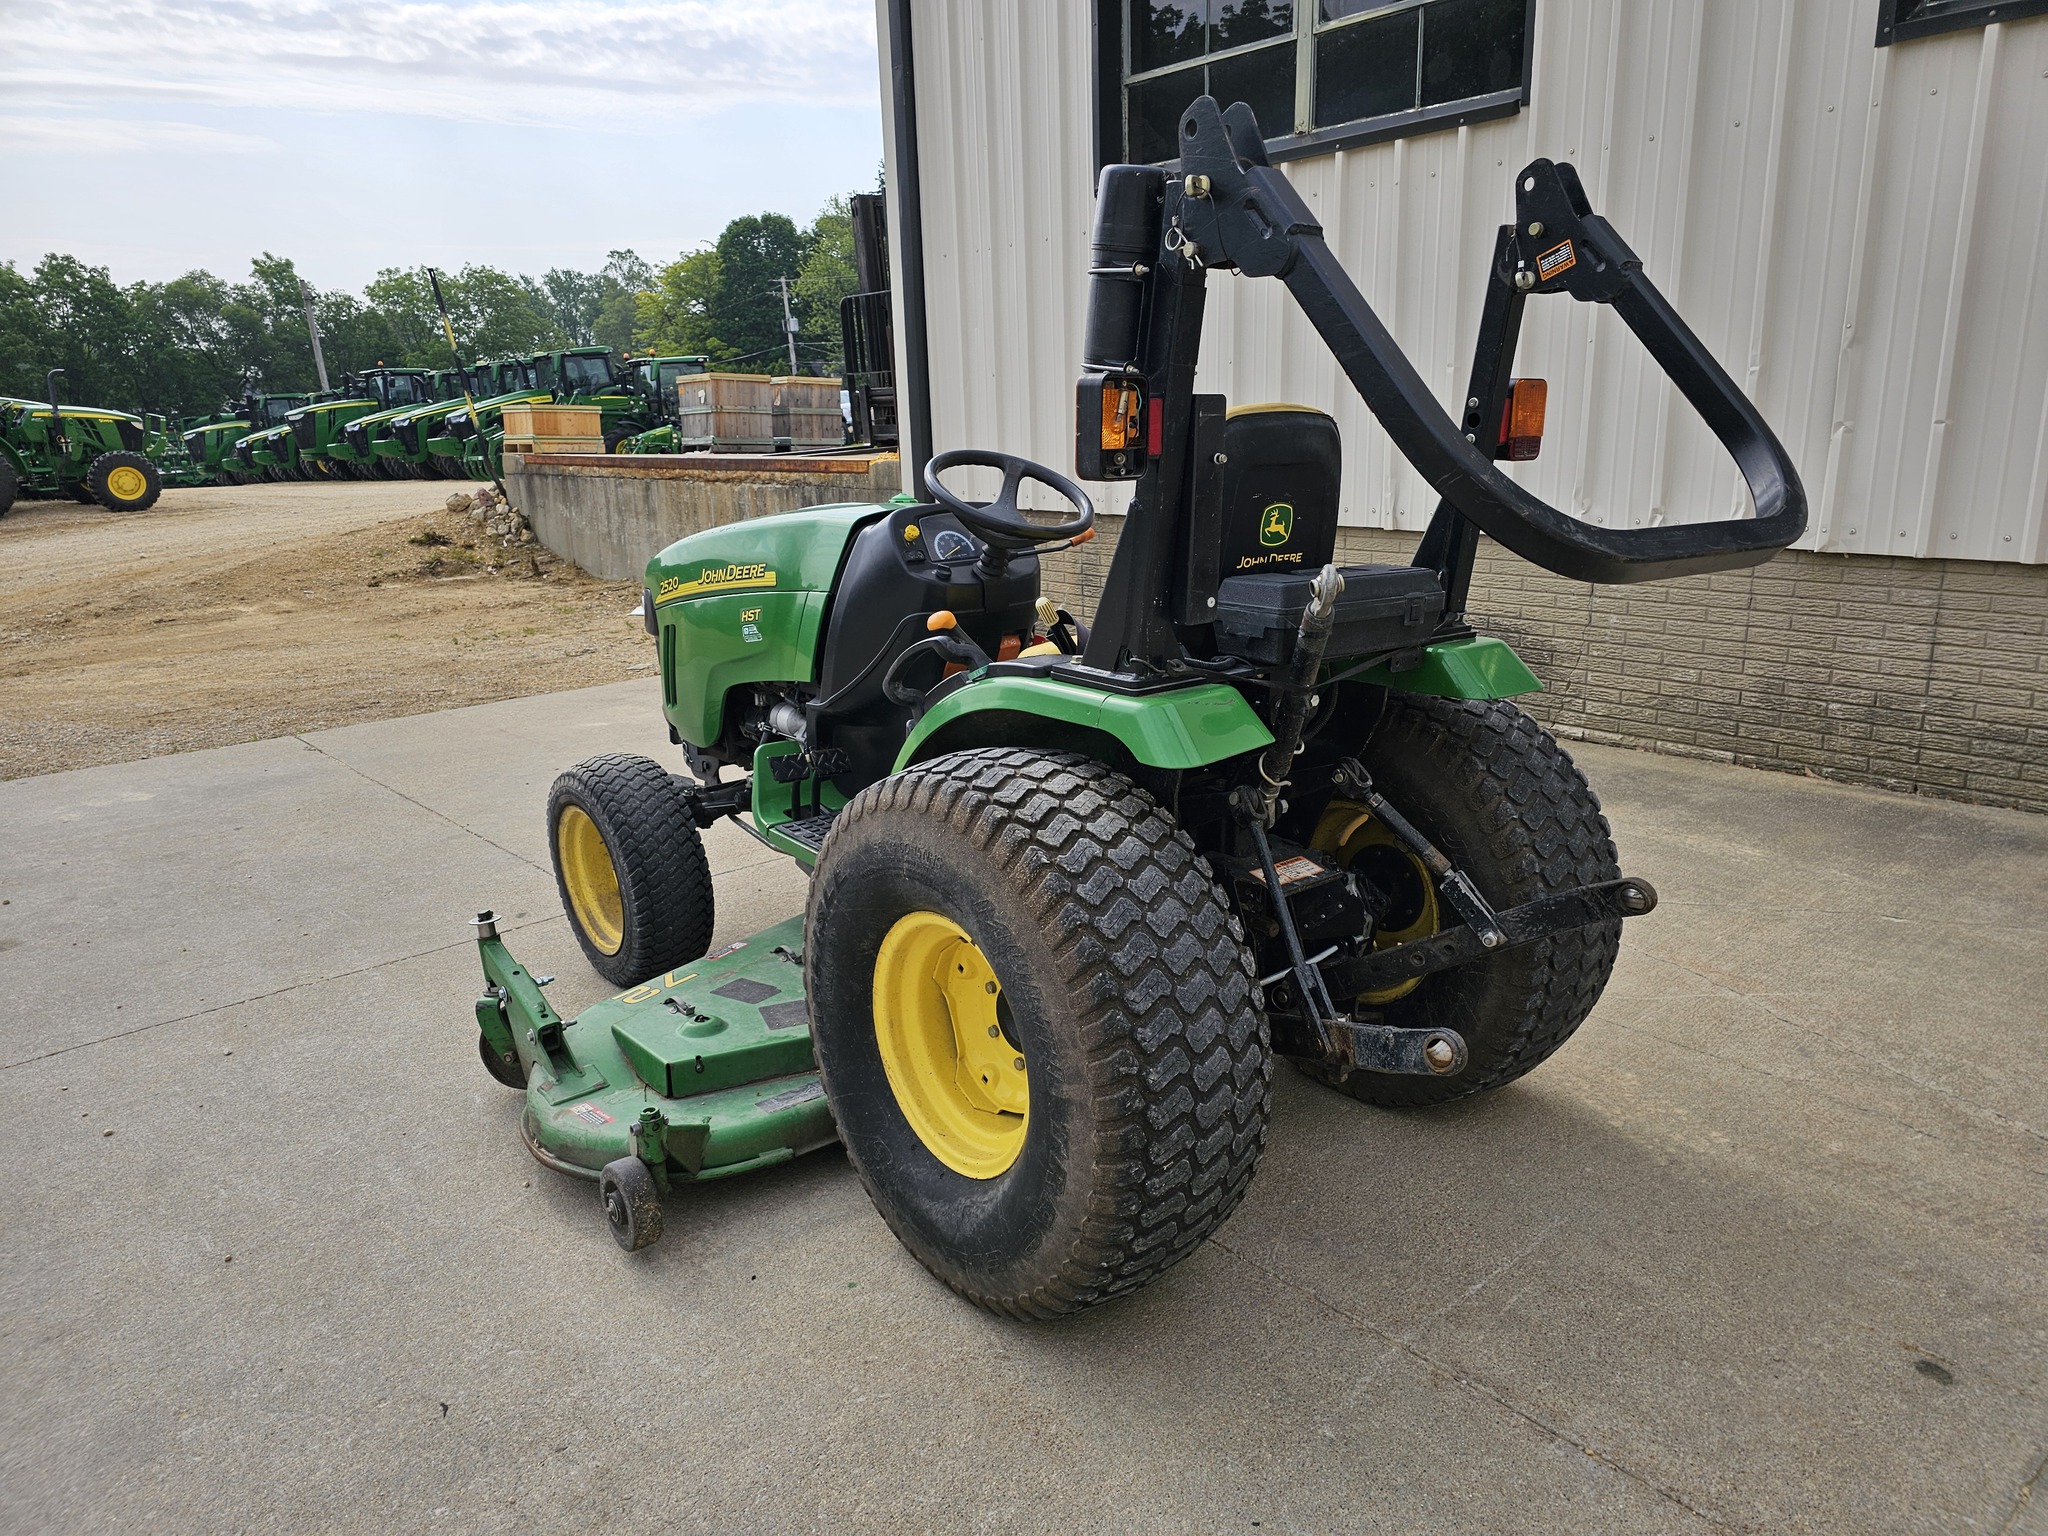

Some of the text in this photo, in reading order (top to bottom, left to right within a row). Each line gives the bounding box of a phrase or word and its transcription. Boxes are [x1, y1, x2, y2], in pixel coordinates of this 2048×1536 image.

[1542, 262, 1570, 279] WARNING
[1236, 552, 1303, 569] JOHN DEERE
[697, 563, 767, 585] JOHN DEERE
[660, 576, 679, 594] 2520
[741, 608, 762, 622] HST
[611, 971, 699, 1005] 72
